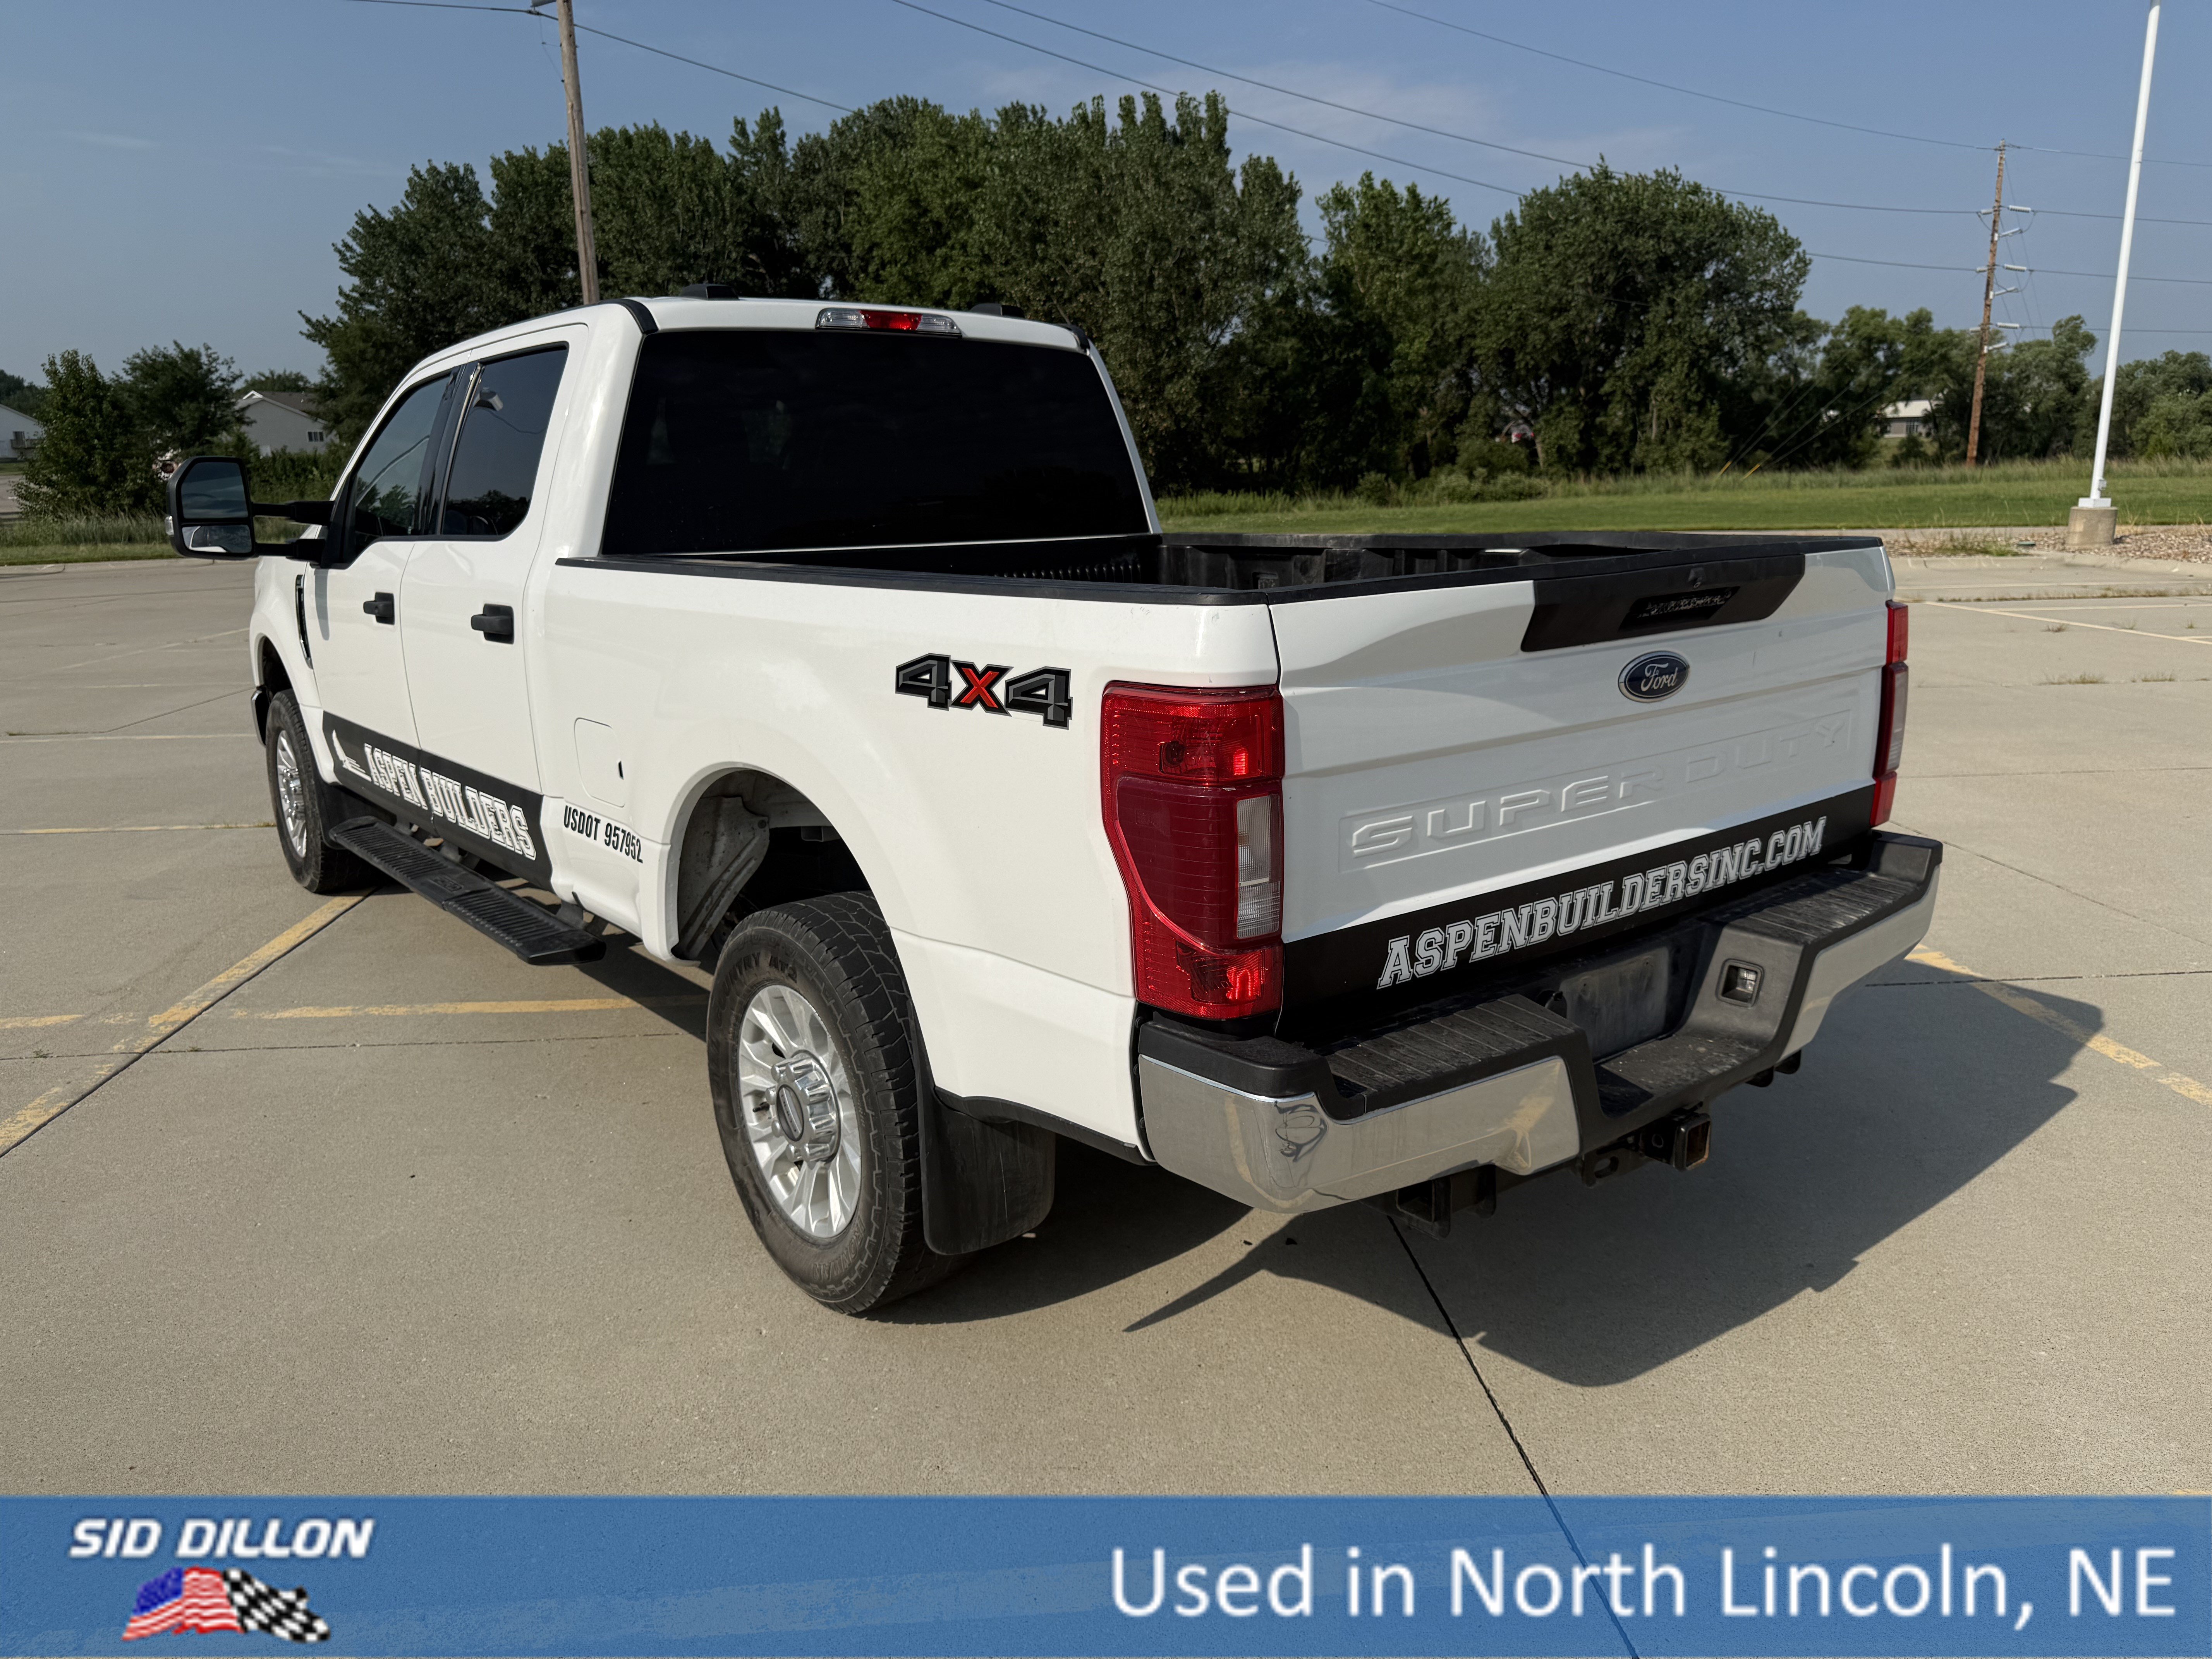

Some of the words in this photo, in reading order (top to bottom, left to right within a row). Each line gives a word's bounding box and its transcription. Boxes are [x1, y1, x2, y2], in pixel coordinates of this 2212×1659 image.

[1640, 662, 1678, 692] Ford
[364, 743, 428, 811] ASPEN
[421, 767, 537, 861] BUILDERS
[563, 805, 601, 841] USDOT
[605, 823, 643, 864] 957952
[1352, 766, 1664, 859] SUPER
[1686, 720, 1846, 784] DUTY
[1377, 817, 1827, 990] ASPENBUILDERSINC.COM
